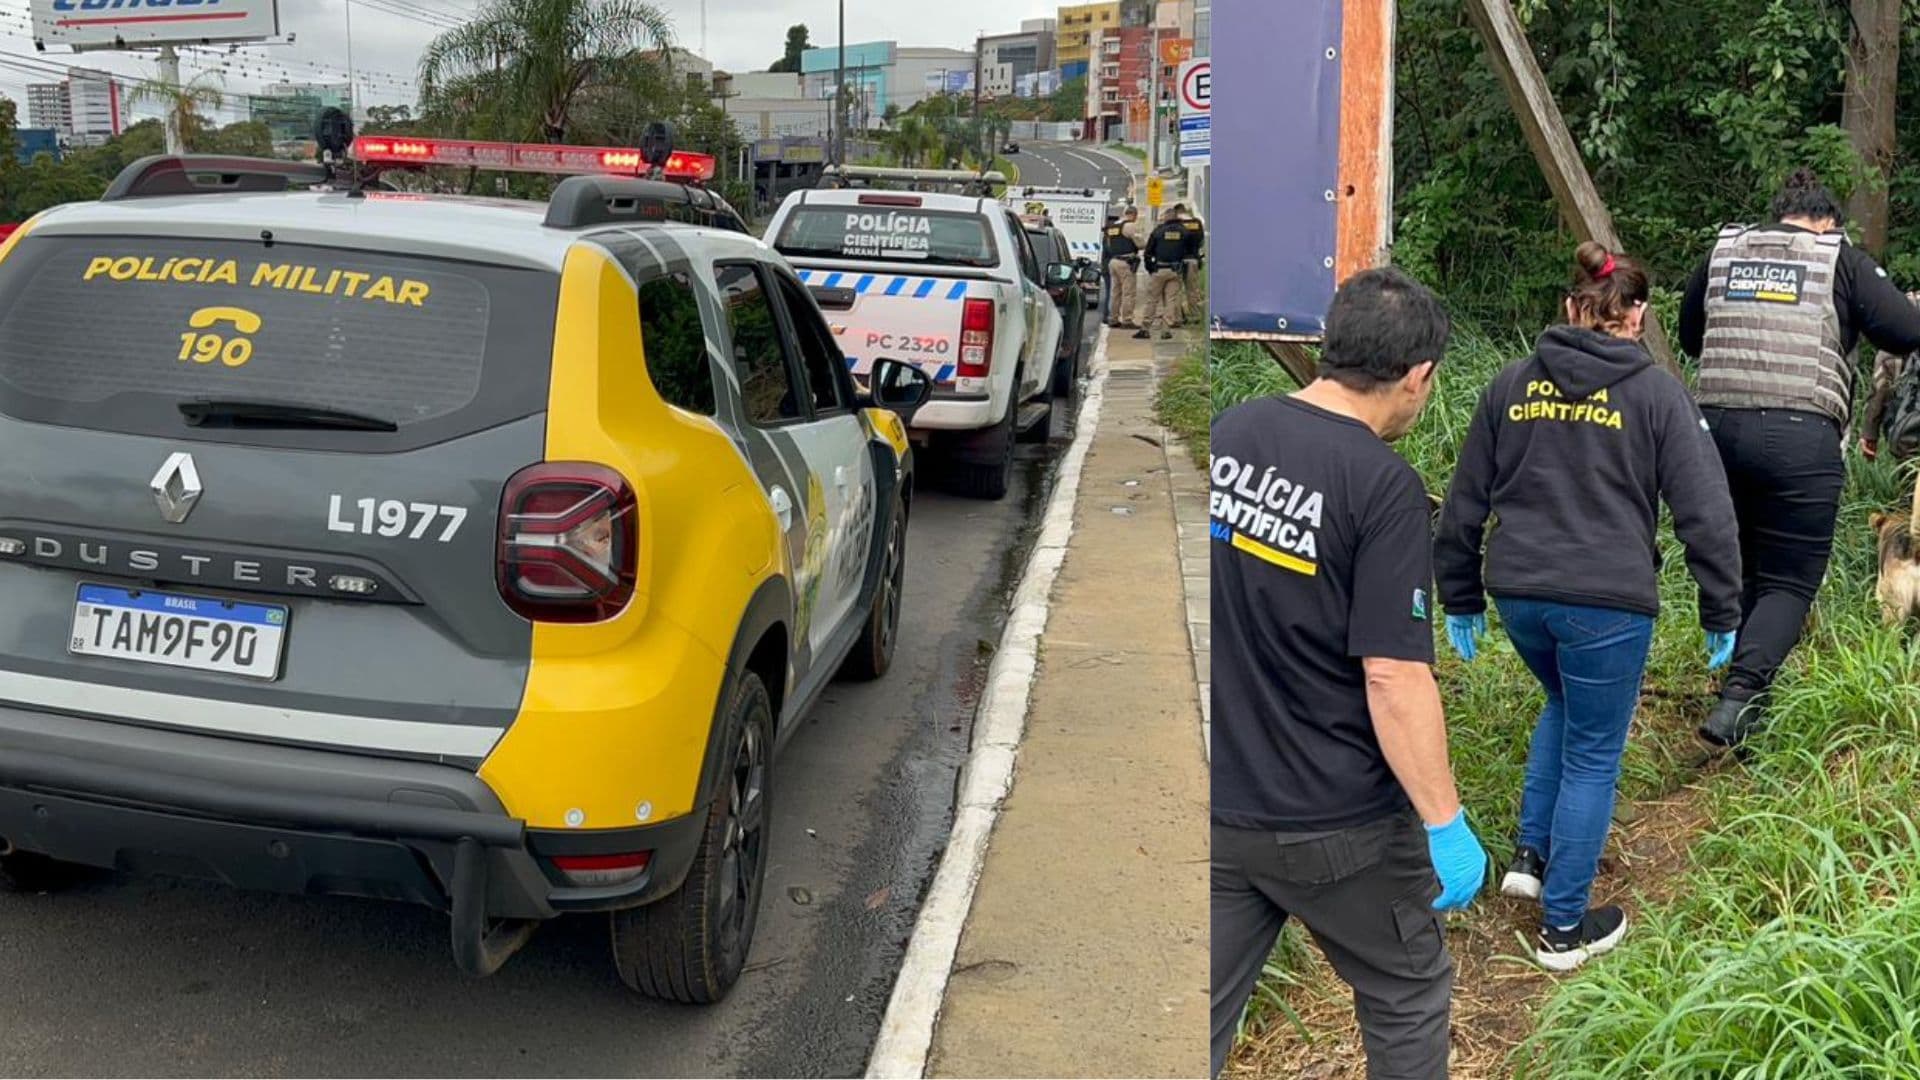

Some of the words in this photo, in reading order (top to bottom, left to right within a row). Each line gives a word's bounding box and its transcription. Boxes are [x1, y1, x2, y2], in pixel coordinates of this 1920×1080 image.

[845, 211, 931, 234] POLÍCIA
[844, 233, 930, 250] CIENTÍFICA
[83, 256, 238, 284] POLÍCIA
[250, 262, 430, 307] MILITAR
[1731, 264, 1798, 281] POLÍCIA
[1728, 278, 1798, 294] CIENTÍFICA
[177, 332, 252, 367] 190
[866, 333, 892, 349] PC
[898, 336, 949, 354] 2320
[1508, 400, 1622, 430] CIENTÍFICA
[1210, 453, 1324, 529] OLÍCIA
[327, 494, 468, 543] L1977
[34, 536, 317, 588] DUSTER
[164, 596, 197, 611] BRASIL
[72, 637, 85, 651] BR
[93, 607, 258, 667] TAM9F90
